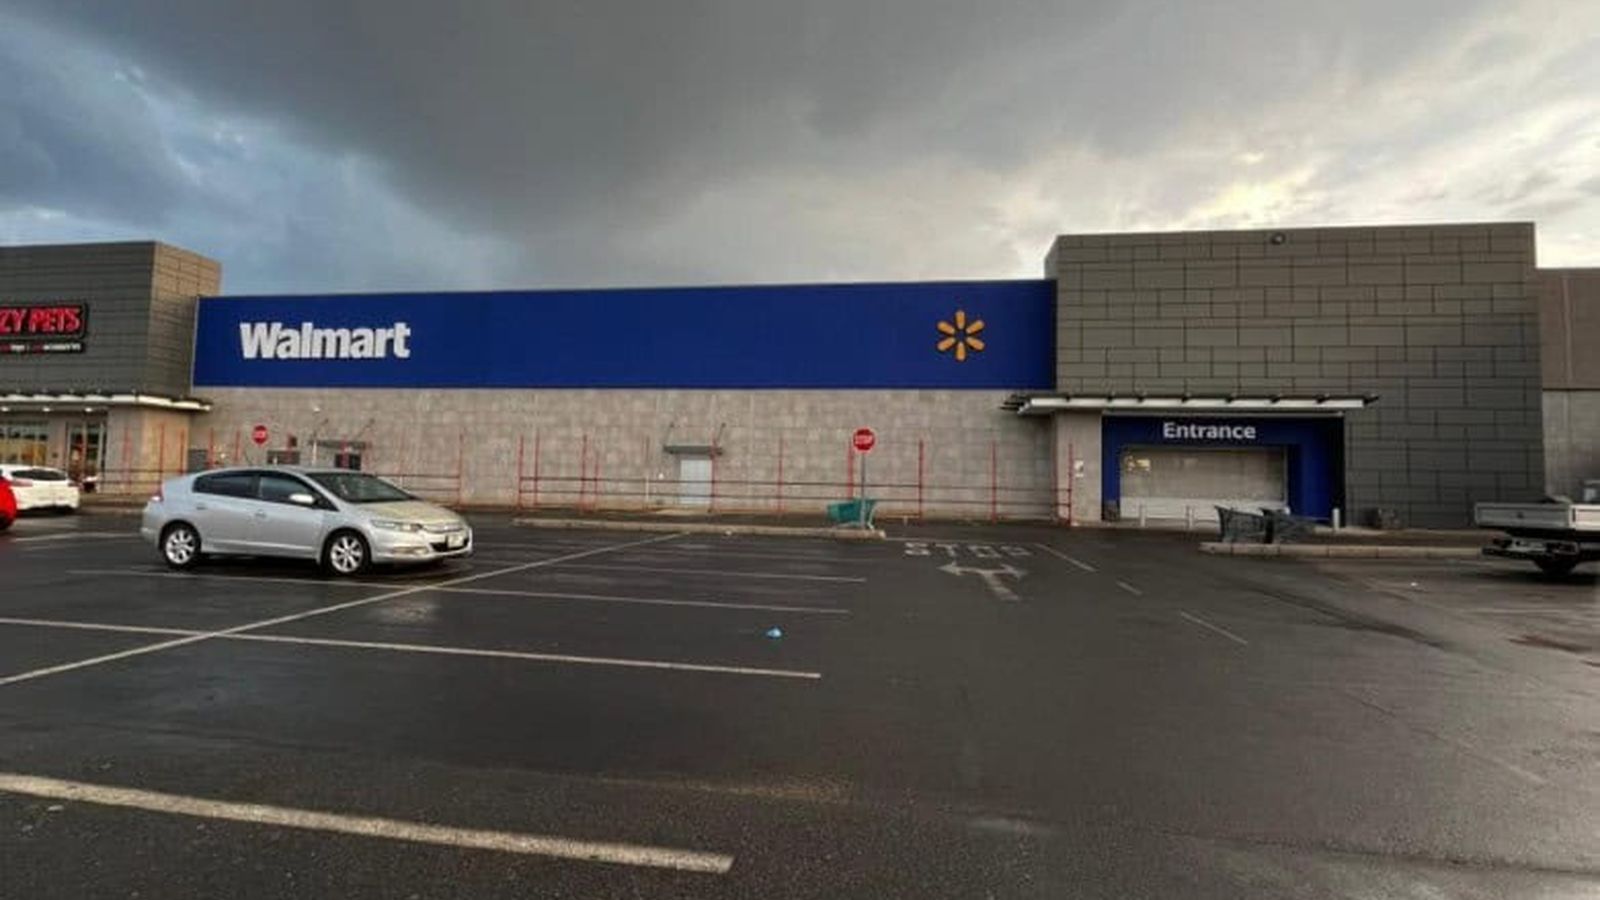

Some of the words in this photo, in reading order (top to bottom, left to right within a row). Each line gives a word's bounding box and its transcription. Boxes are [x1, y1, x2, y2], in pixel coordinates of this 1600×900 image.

[29, 308, 80, 332] PETS
[239, 322, 411, 359] Walmart
[1163, 422, 1256, 439] Entrance
[904, 541, 1032, 558] STOP
